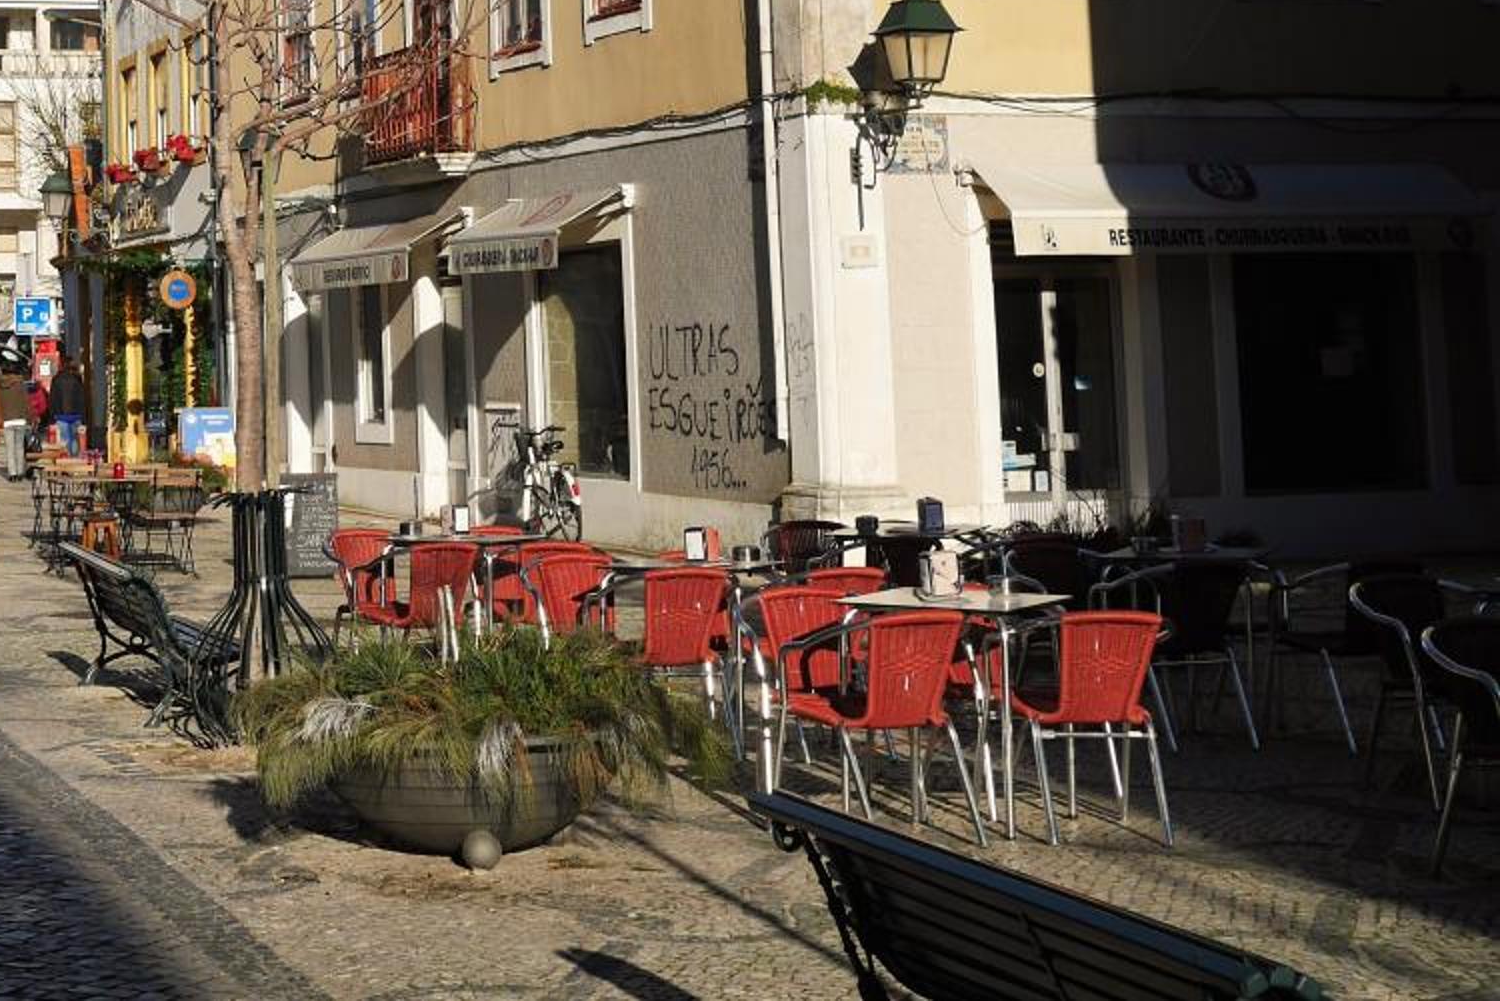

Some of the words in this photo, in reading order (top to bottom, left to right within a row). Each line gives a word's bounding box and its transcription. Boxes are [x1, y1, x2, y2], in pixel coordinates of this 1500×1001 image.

[1108, 228, 1206, 247] RESTAURANTE
[21, 307, 34, 322] P
[648, 323, 739, 381] ULTRAS
